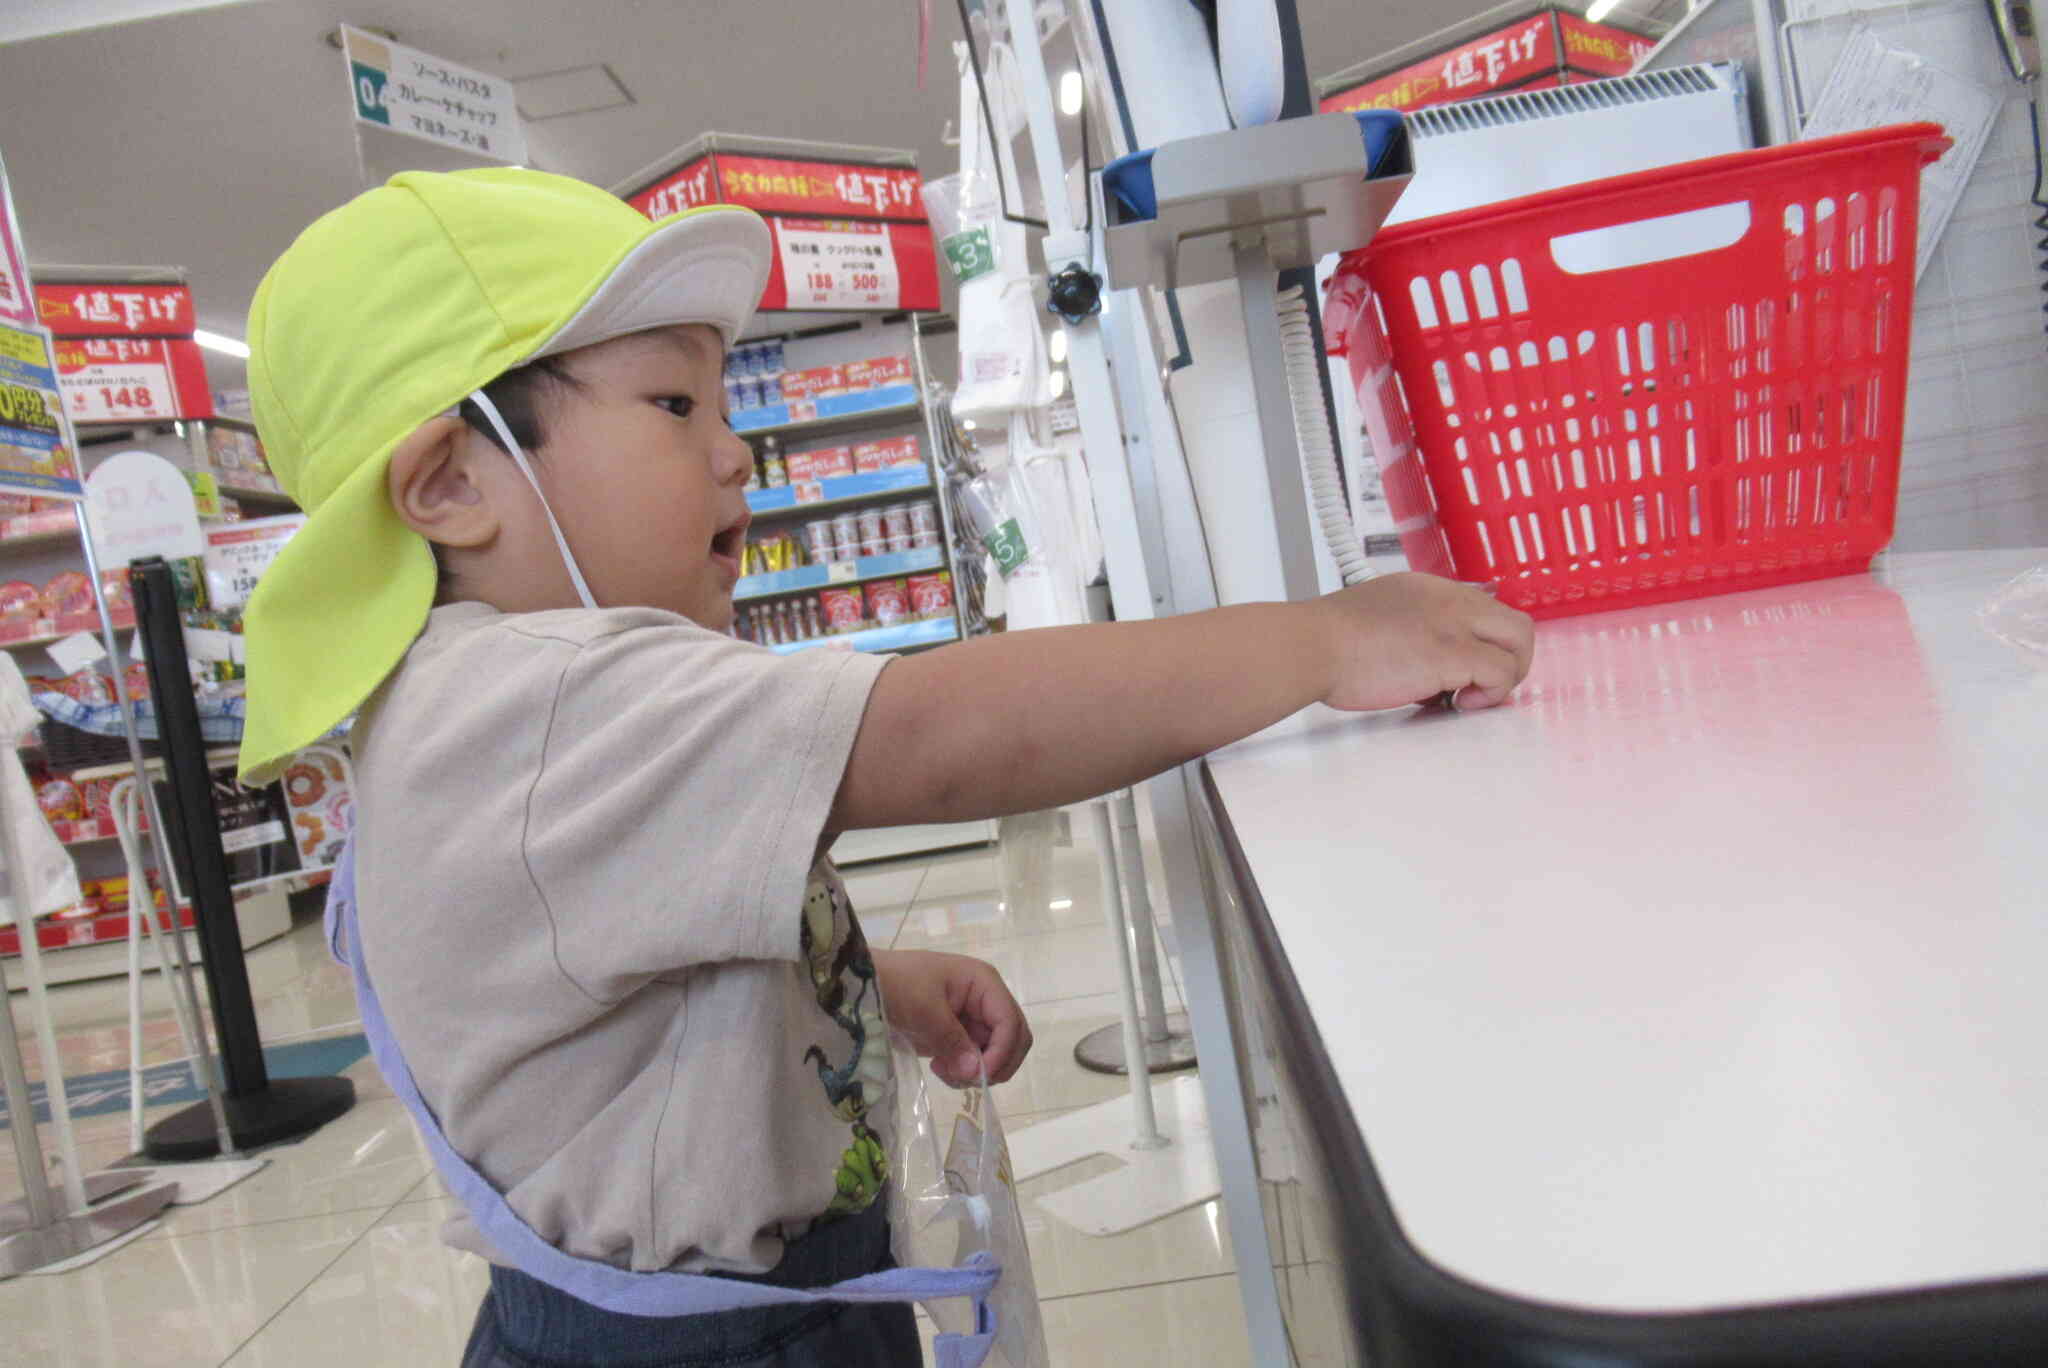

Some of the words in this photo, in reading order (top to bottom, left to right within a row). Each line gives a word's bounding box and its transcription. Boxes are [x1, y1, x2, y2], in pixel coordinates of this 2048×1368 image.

[1442, 21, 1545, 89] 値下げ
[648, 166, 708, 221] 値下げ
[835, 172, 918, 214] 値下げ
[958, 242, 979, 270] 3
[806, 273, 834, 290] 188
[852, 273, 880, 291] 500
[73, 291, 184, 332] 値下げ
[99, 386, 153, 409] 148
